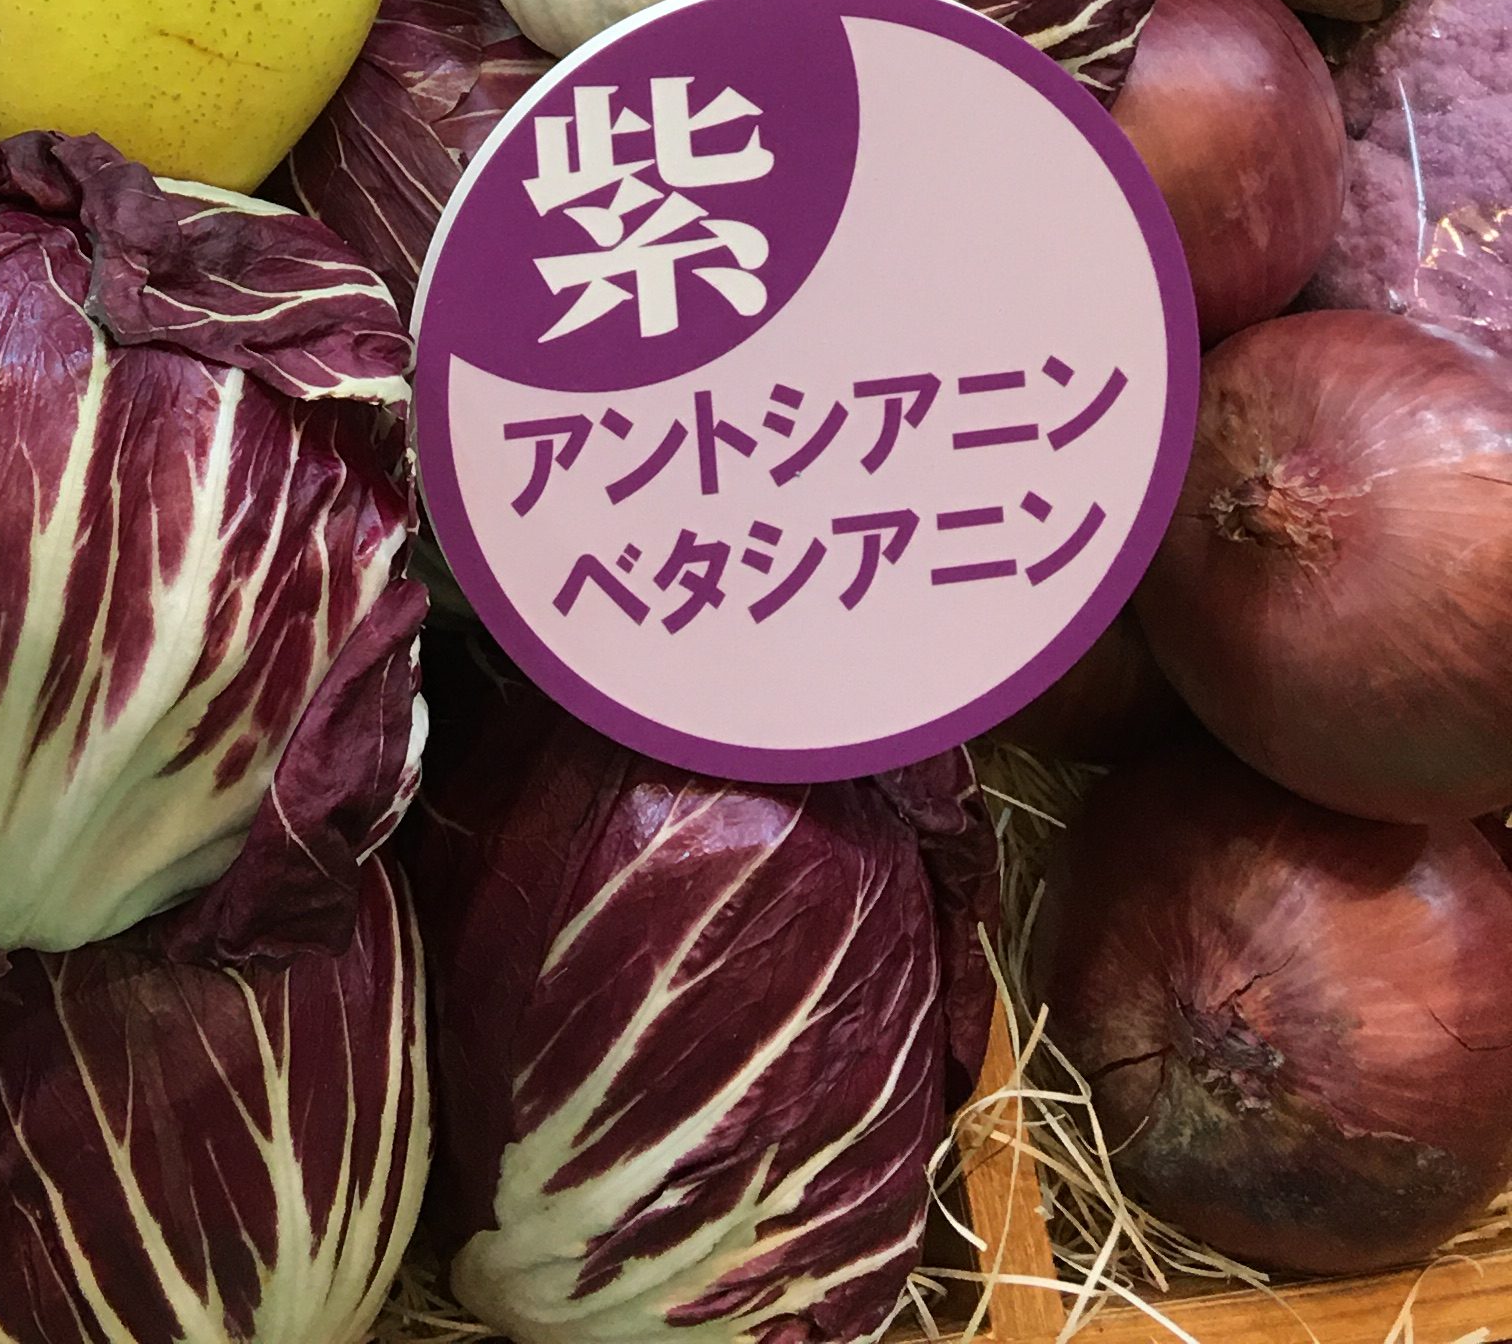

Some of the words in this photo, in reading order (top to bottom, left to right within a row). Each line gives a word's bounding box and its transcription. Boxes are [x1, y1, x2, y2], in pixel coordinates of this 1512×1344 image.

[521, 76, 775, 345] 紫
[502, 355, 1129, 518] アントシアニン
[551, 490, 1107, 636] ベタシアニン
